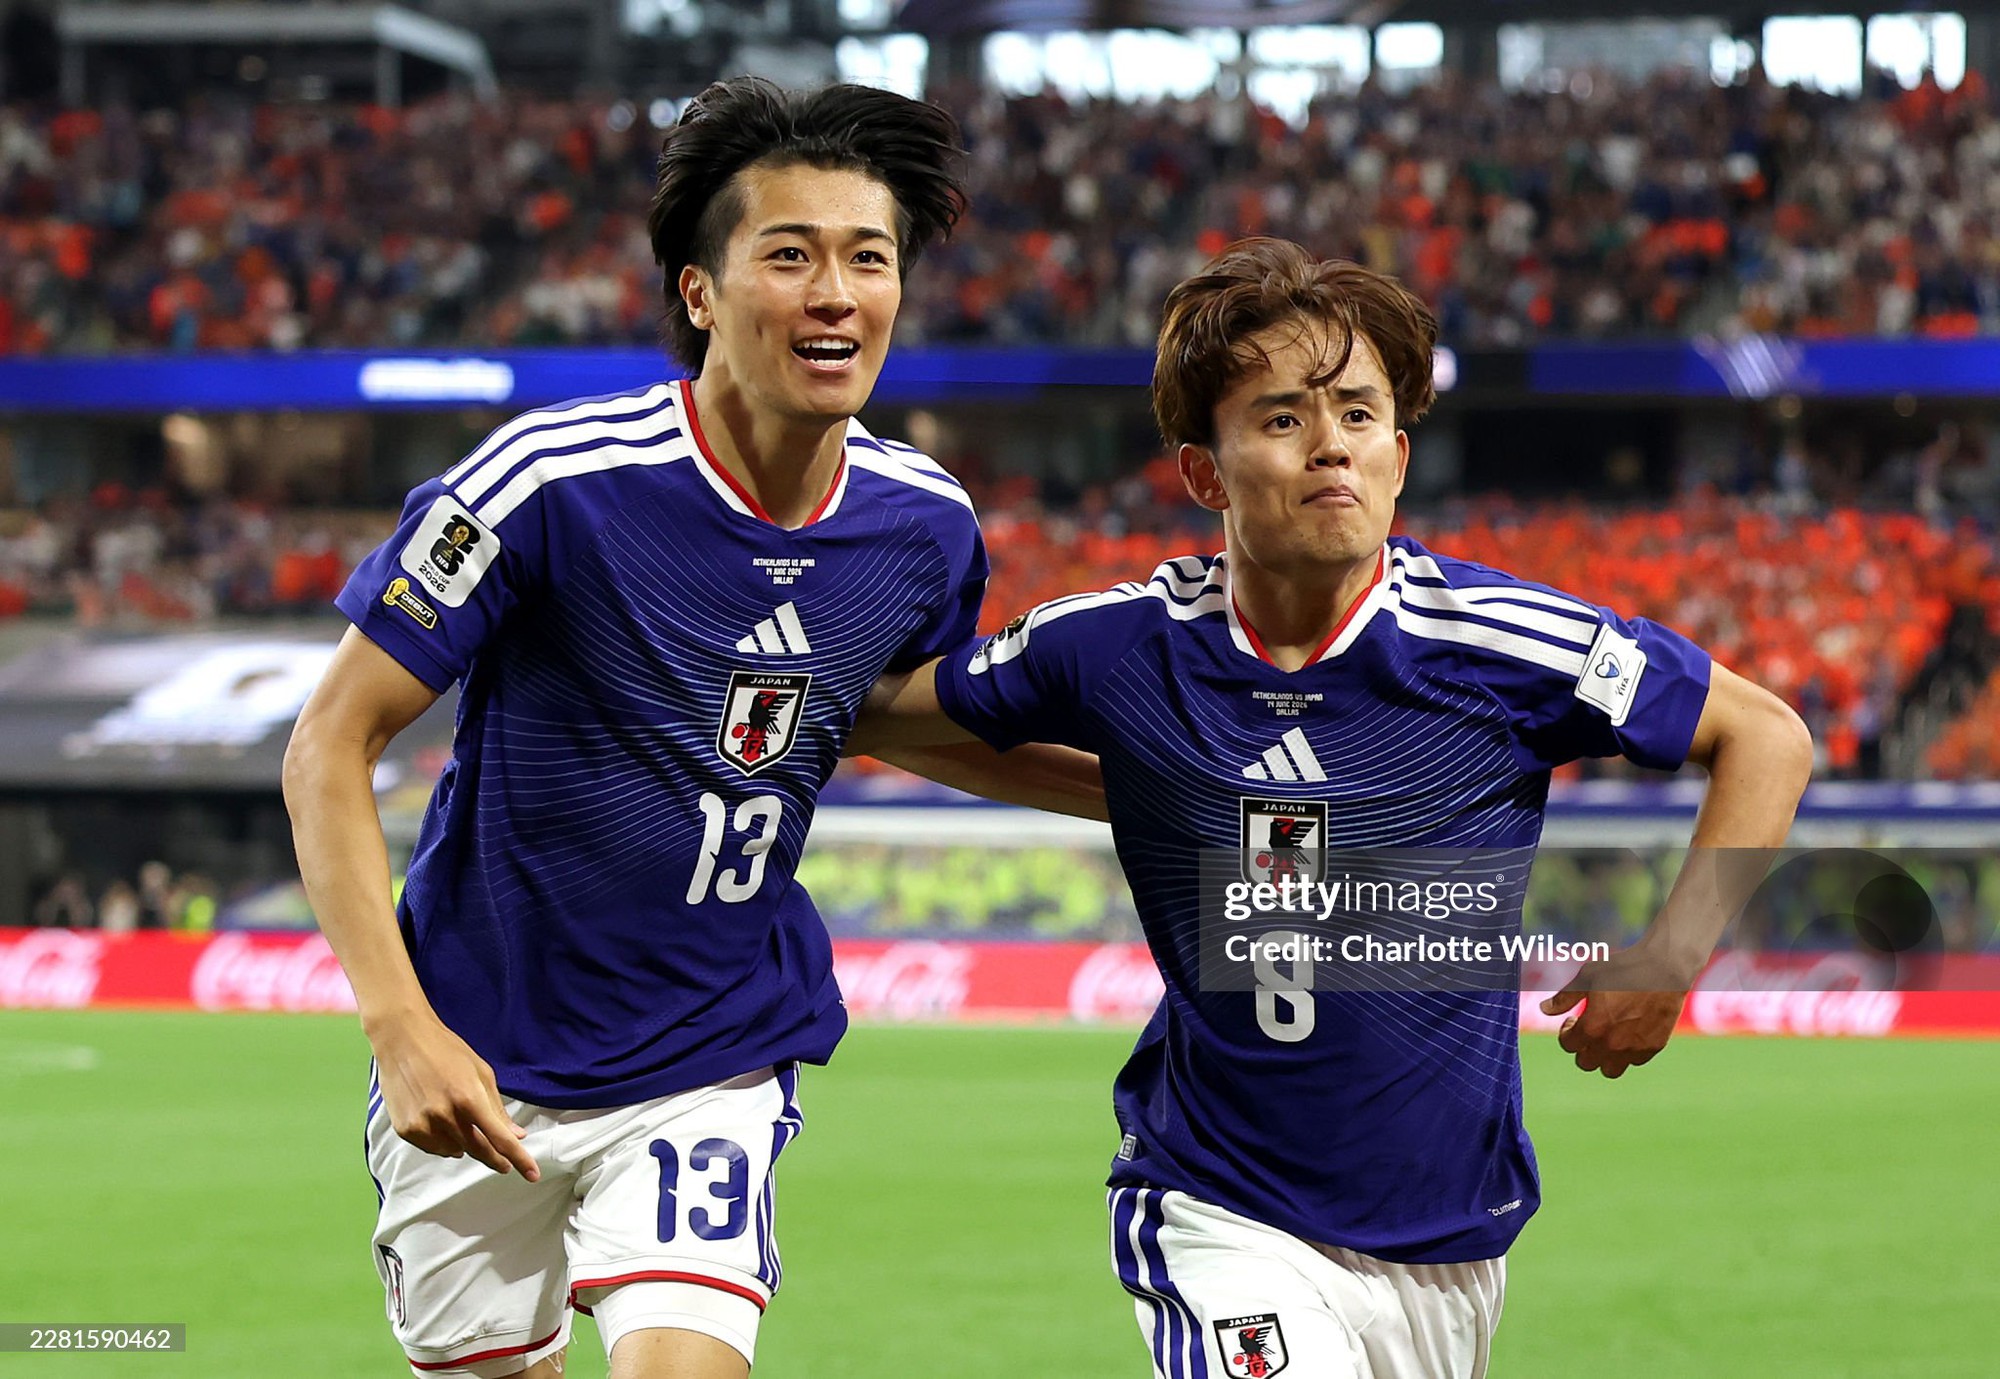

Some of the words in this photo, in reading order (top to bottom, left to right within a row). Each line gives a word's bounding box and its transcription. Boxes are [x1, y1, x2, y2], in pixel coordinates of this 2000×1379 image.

[418, 564, 447, 593] 2026
[401, 592, 434, 619] DEBUT
[750, 677, 791, 686] JAPAN
[734, 740, 769, 755] JFA
[1262, 803, 1306, 813] JAPAN
[686, 792, 782, 905] 13
[1254, 930, 1315, 1042] 8
[649, 1138, 749, 1243] 13
[1228, 1315, 1264, 1327] JAPAN
[1243, 1361, 1273, 1376] JFA
